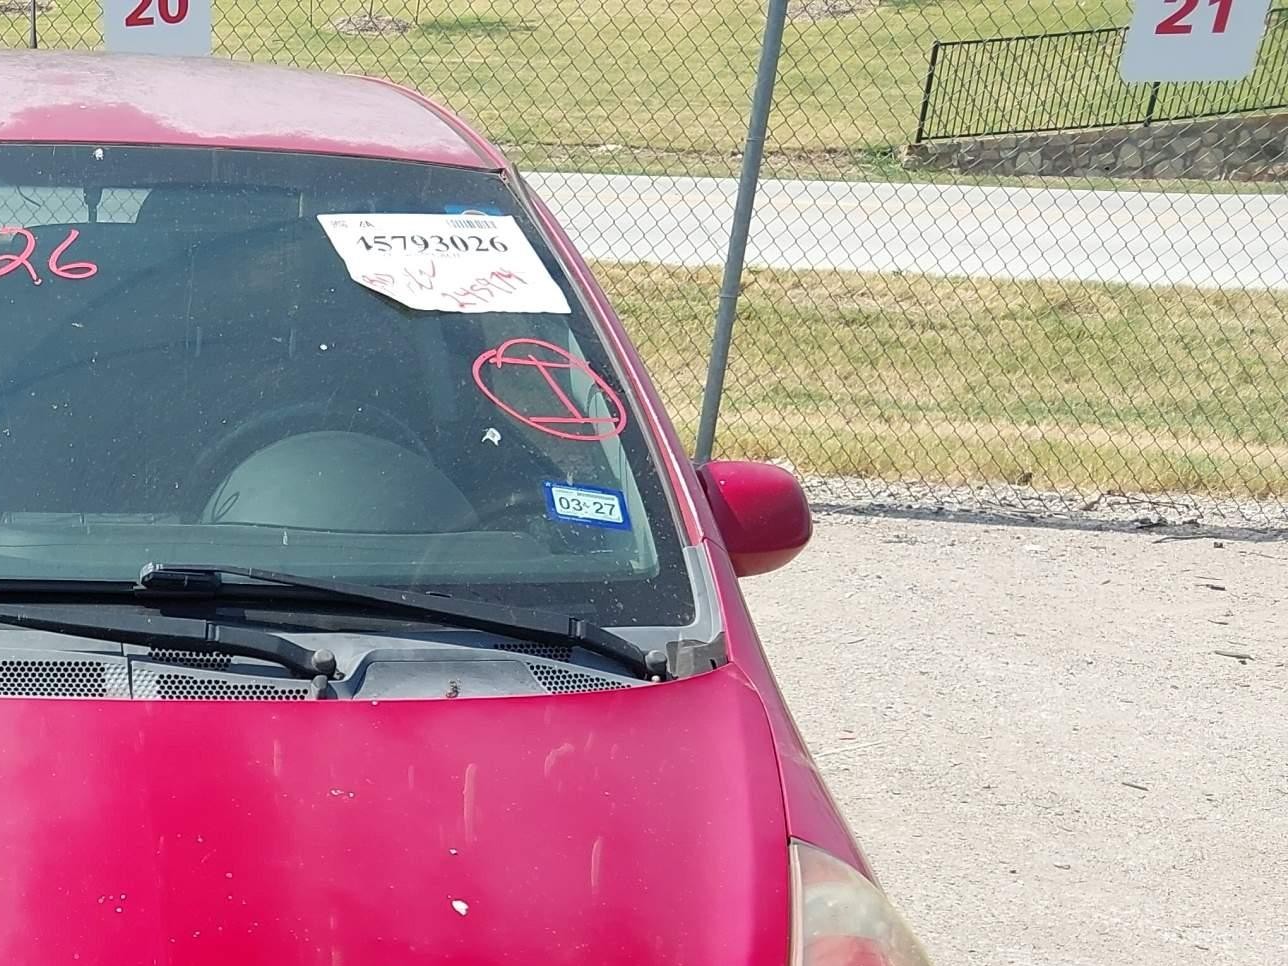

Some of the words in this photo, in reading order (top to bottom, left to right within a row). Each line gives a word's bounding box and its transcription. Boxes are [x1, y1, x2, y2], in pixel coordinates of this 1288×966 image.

[125, 0, 189, 27] 20
[1154, 0, 1233, 35] 21
[592, 501, 616, 516] 27
